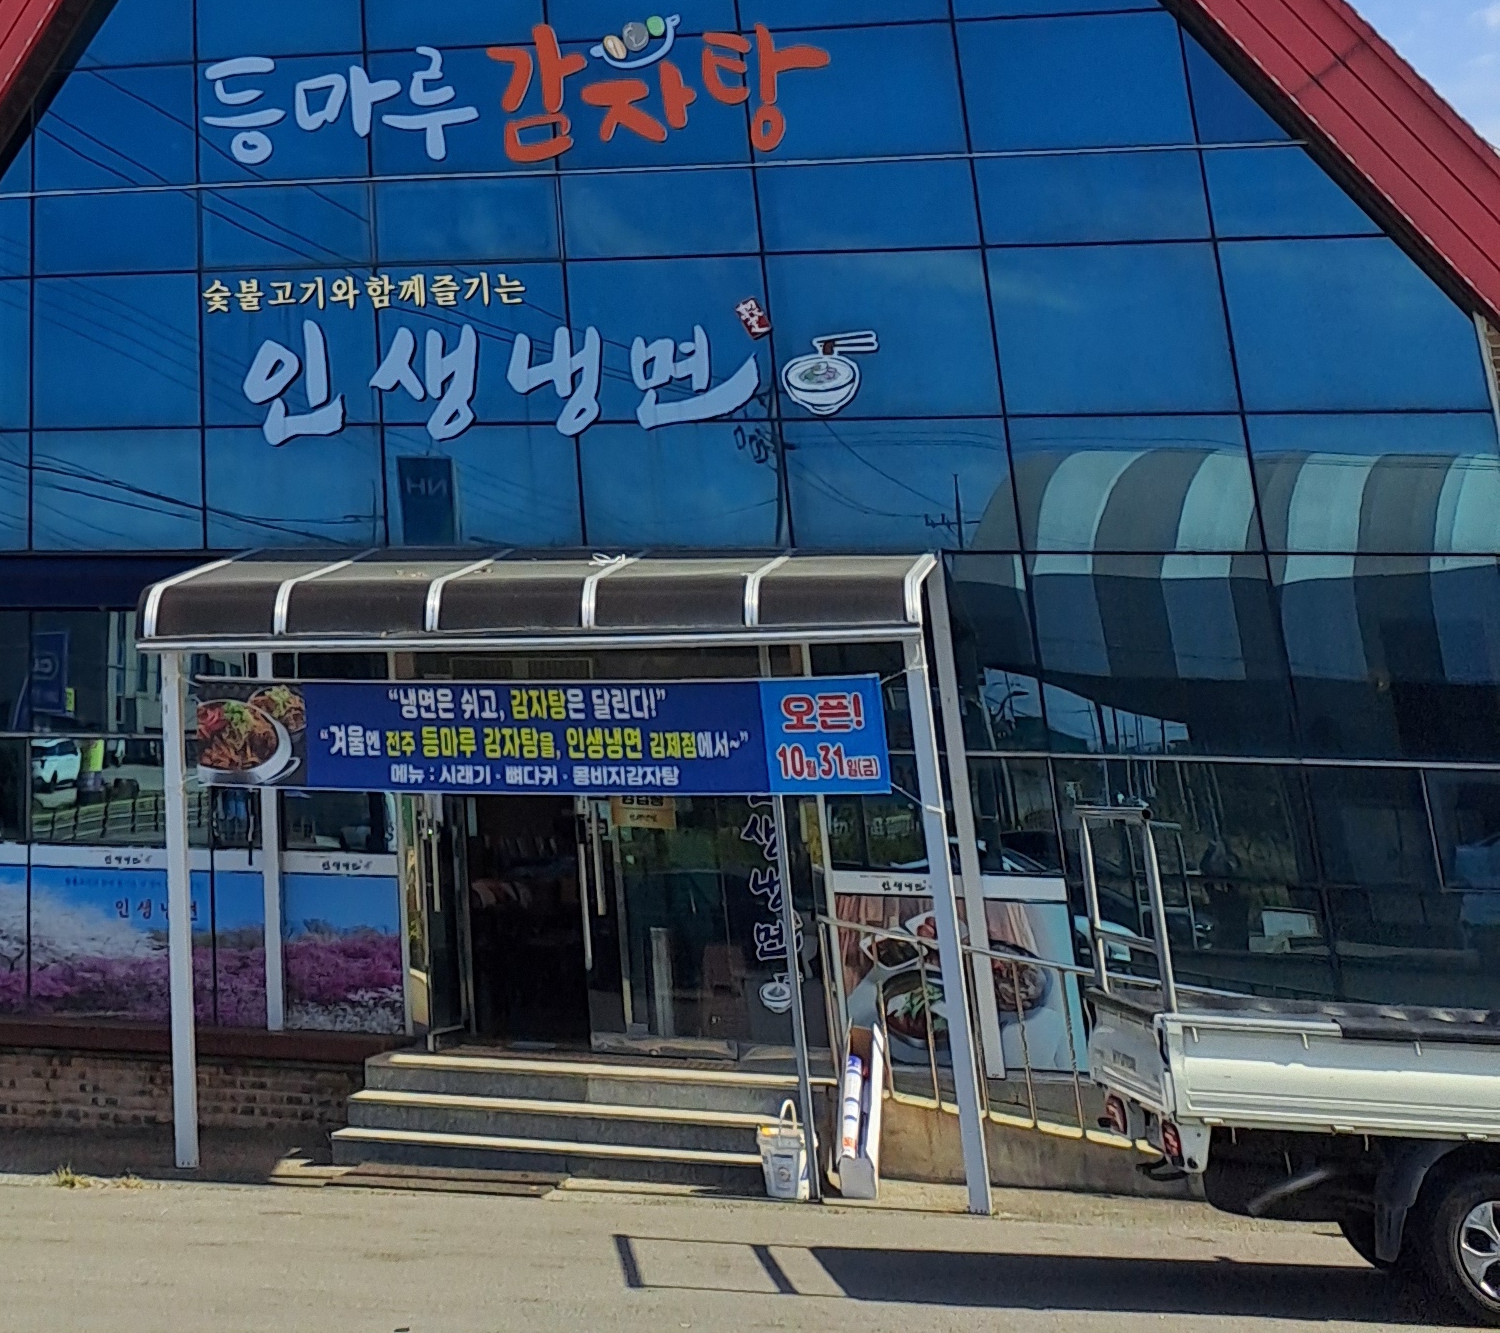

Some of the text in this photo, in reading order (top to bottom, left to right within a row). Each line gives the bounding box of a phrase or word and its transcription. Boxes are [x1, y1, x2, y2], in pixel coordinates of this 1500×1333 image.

[202, 23, 830, 164] 등마루 감자탕
[203, 277, 360, 313] 숯불고기와
[243, 320, 760, 446] 인생냉면
[510, 688, 586, 720] 감자탕은
[781, 692, 865, 733] 오픈!
[385, 729, 416, 758] 전주
[421, 726, 477, 759] 등마루
[566, 725, 644, 759] 인생냉면
[390, 763, 425, 784] 메뉴
[438, 764, 491, 785] 시래기
[505, 765, 558, 786] 뼈다귀
[572, 765, 679, 787] 콩비지감자탕
[776, 742, 818, 780] 10월
